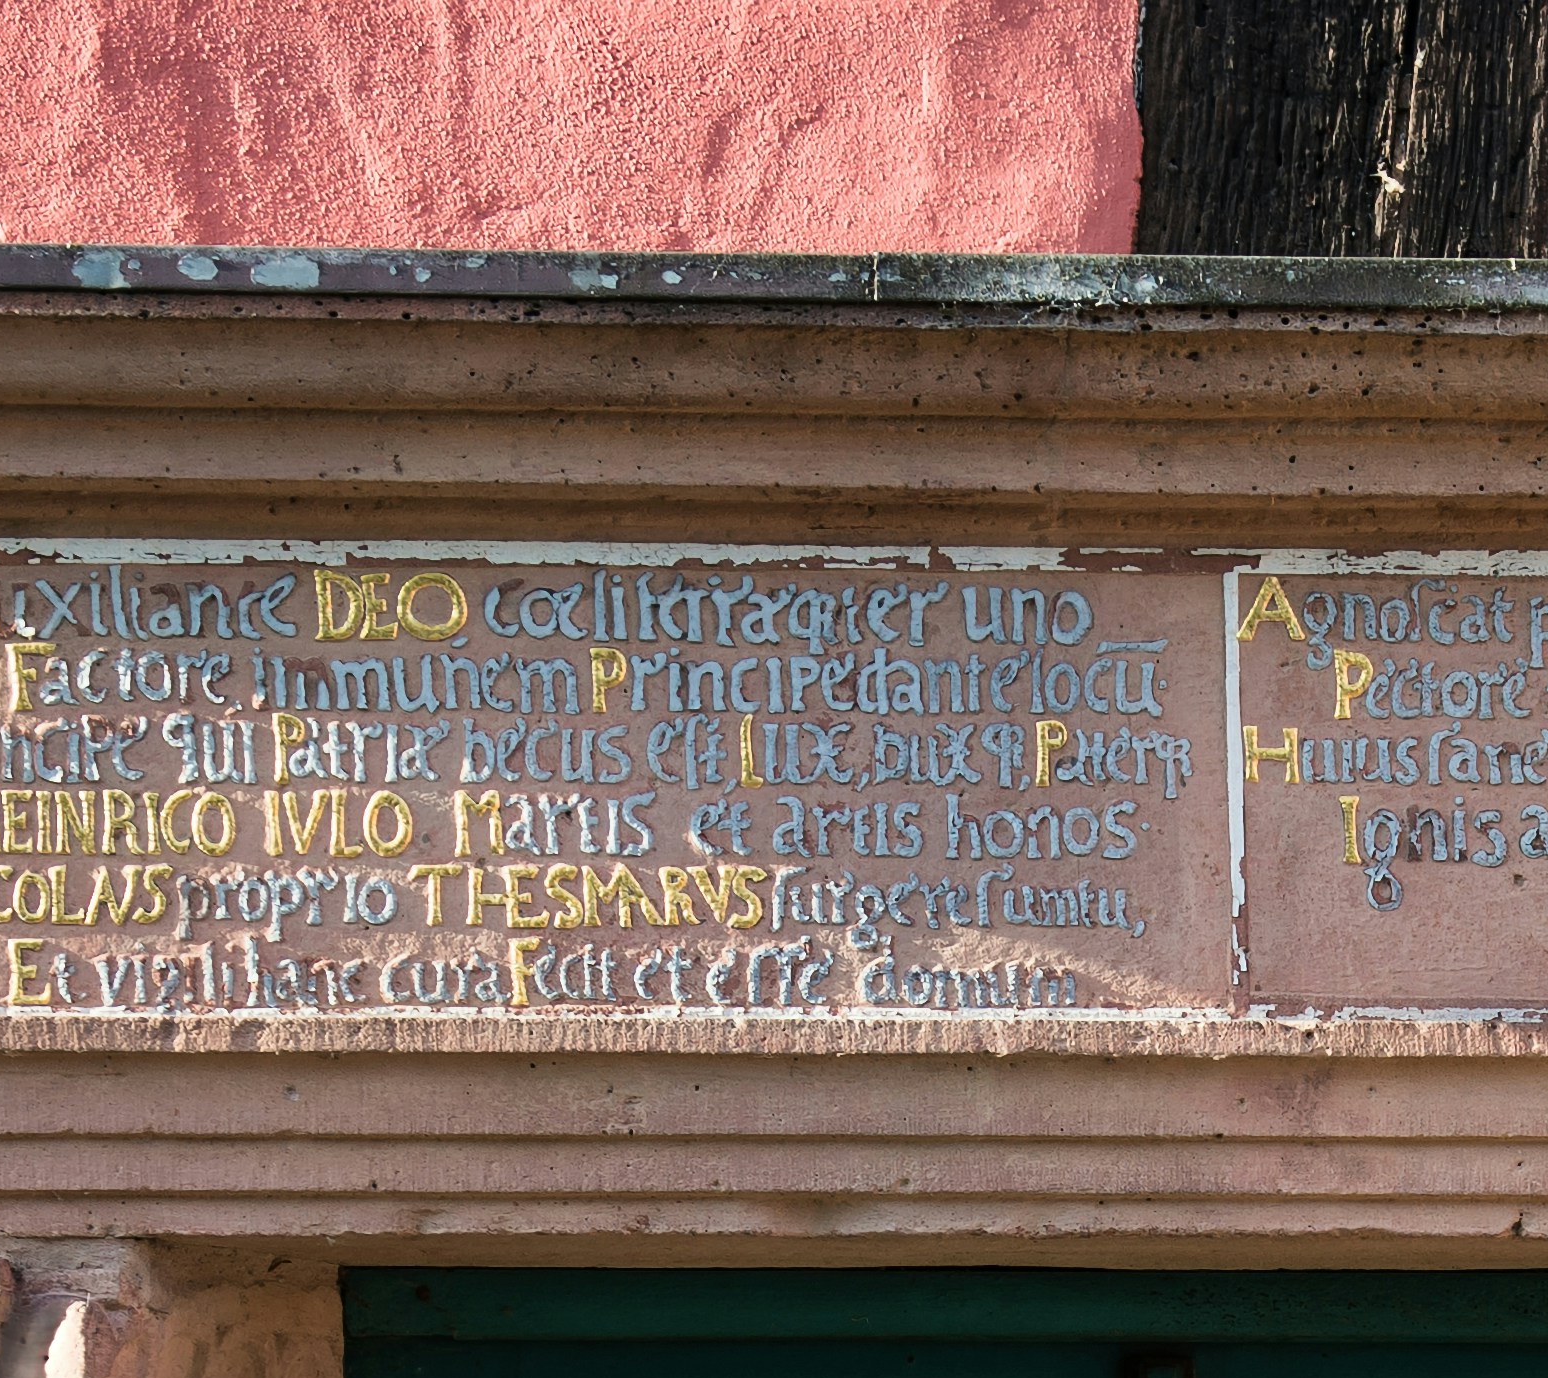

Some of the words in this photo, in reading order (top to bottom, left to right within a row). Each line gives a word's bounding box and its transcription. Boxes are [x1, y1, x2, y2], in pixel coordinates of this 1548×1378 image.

[314, 568, 469, 642] DEO
[961, 585, 1095, 646] uno
[163, 712, 259, 785] qui
[687, 798, 753, 858] et
[1338, 796, 1509, 912] Ignis
[175, 866, 399, 943] proprio
[407, 862, 768, 930] THESMARVS
